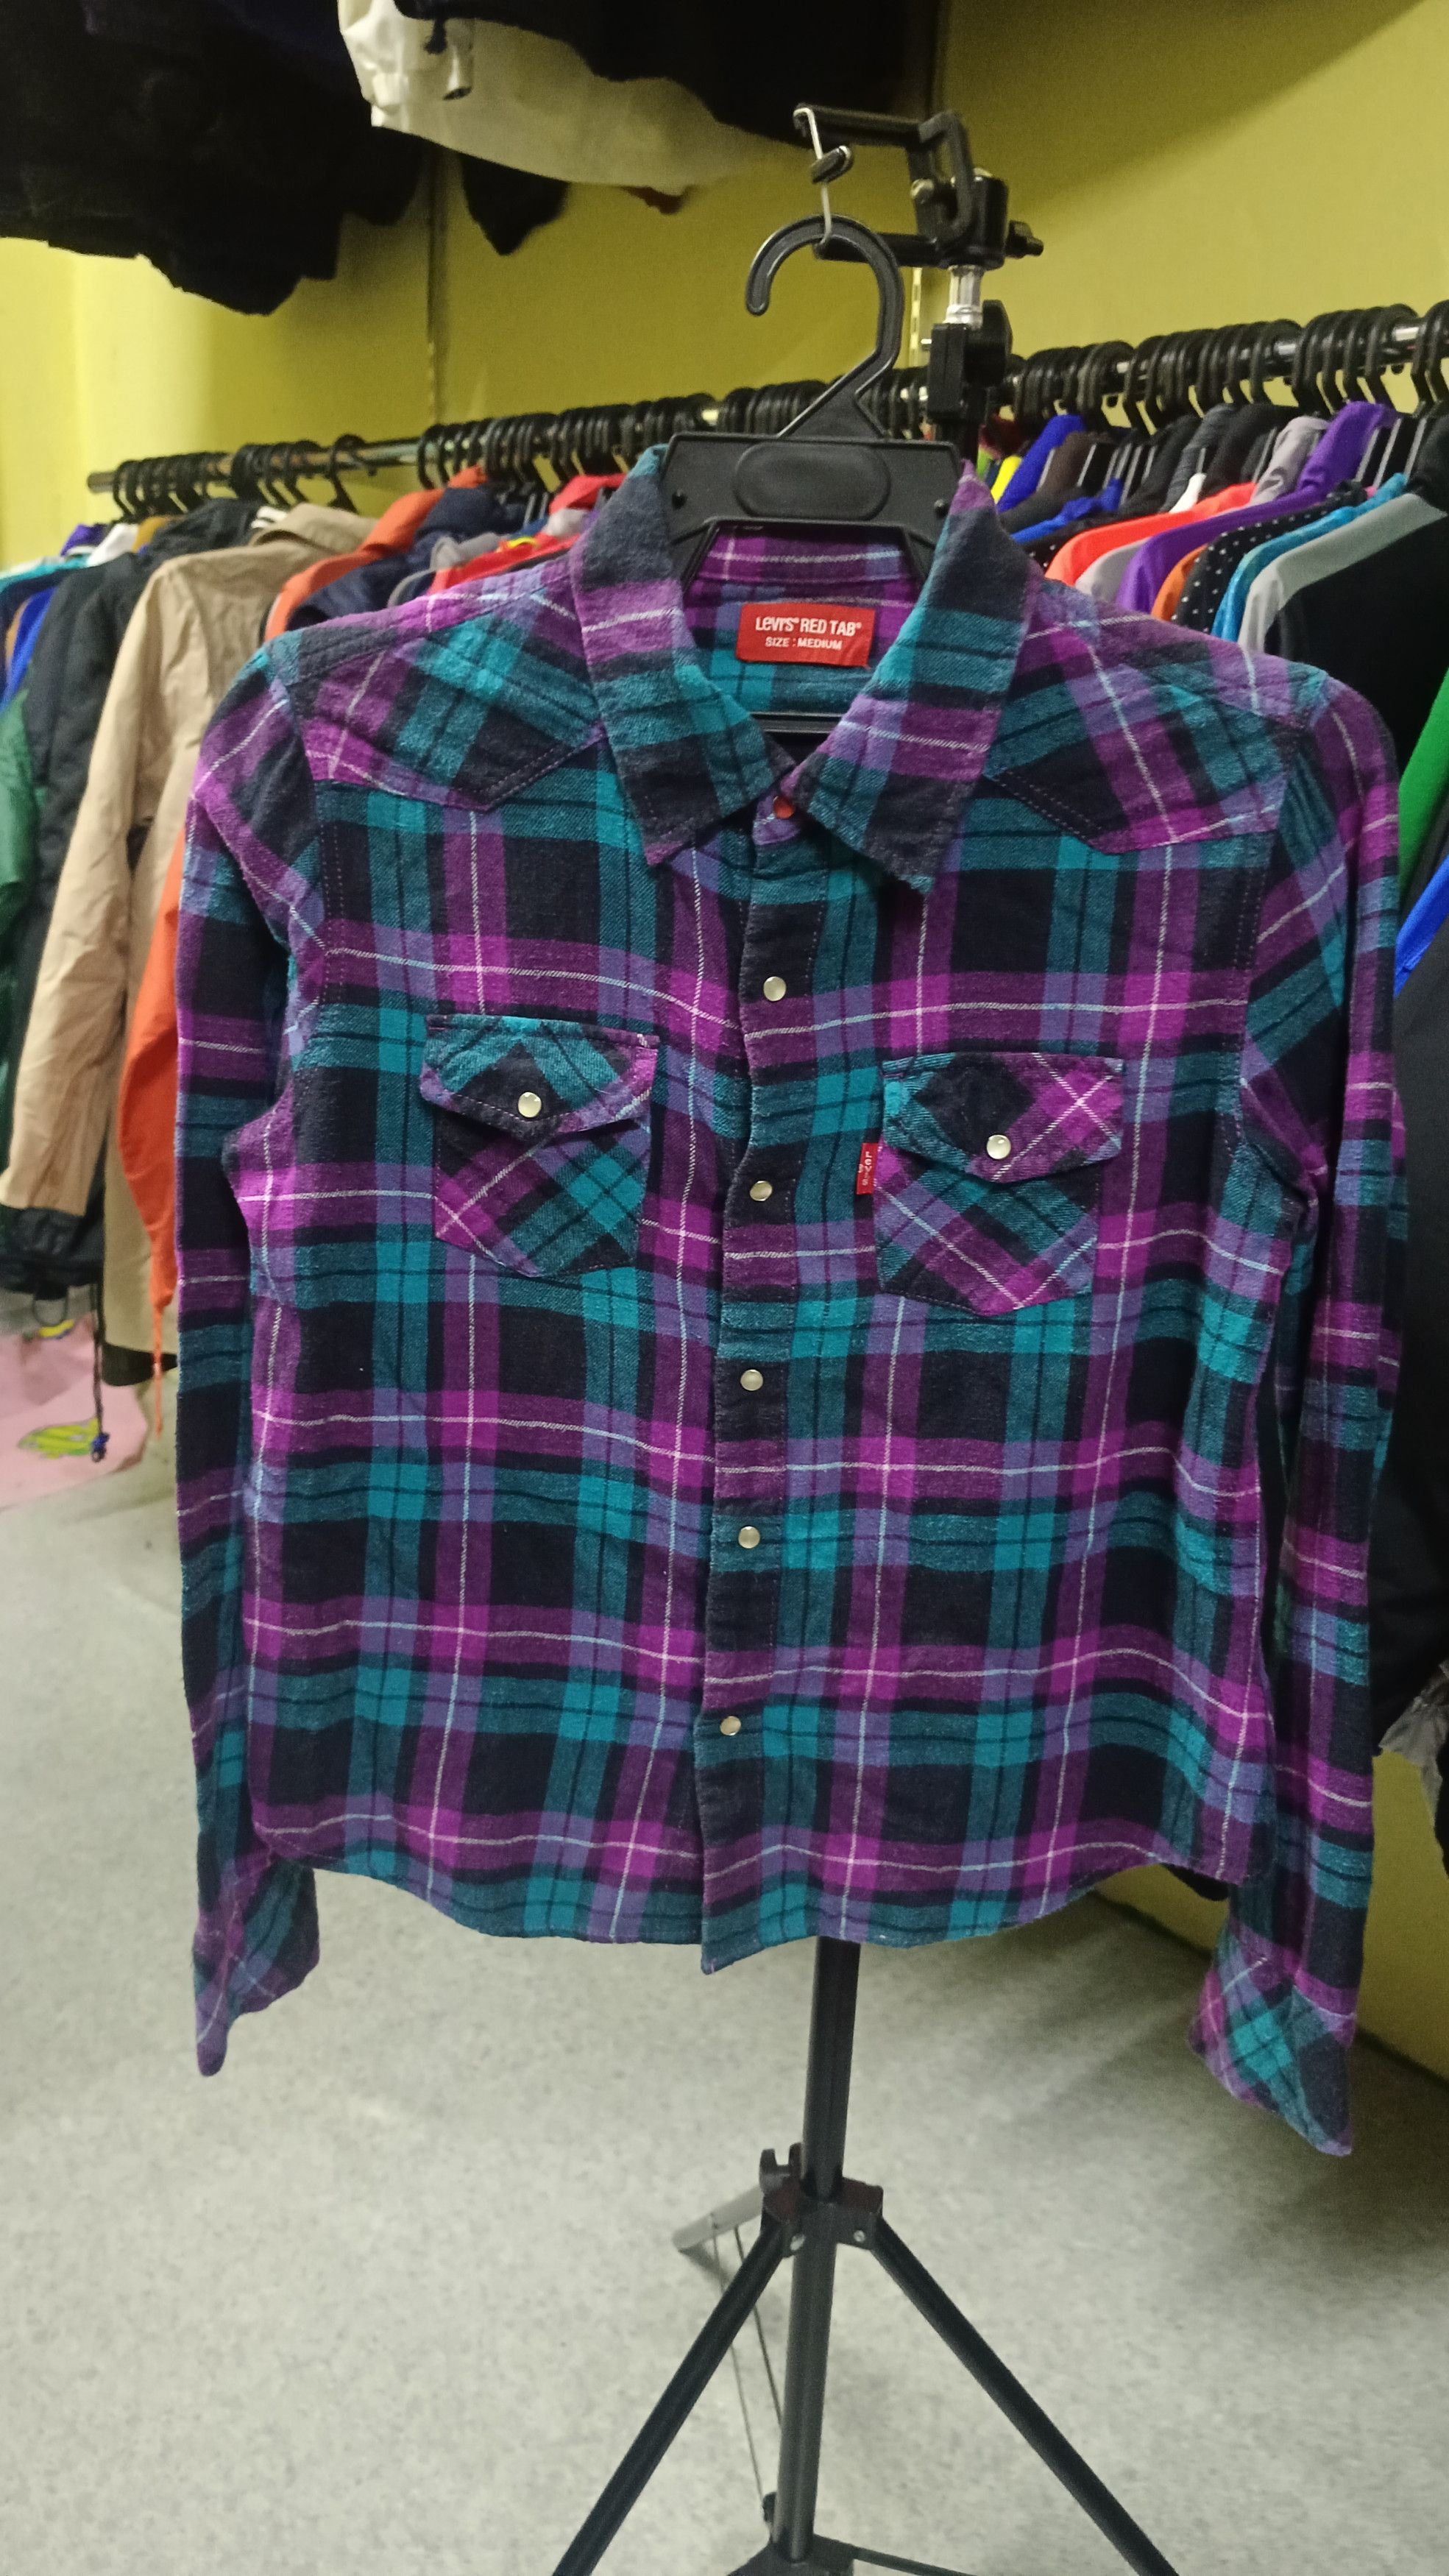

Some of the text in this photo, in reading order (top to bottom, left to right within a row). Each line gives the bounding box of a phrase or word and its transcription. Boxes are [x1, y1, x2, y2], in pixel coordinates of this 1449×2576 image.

[799, 617, 828, 634] RED
[765, 636, 790, 648] SIZE
[797, 637, 843, 651] MEDIUM
